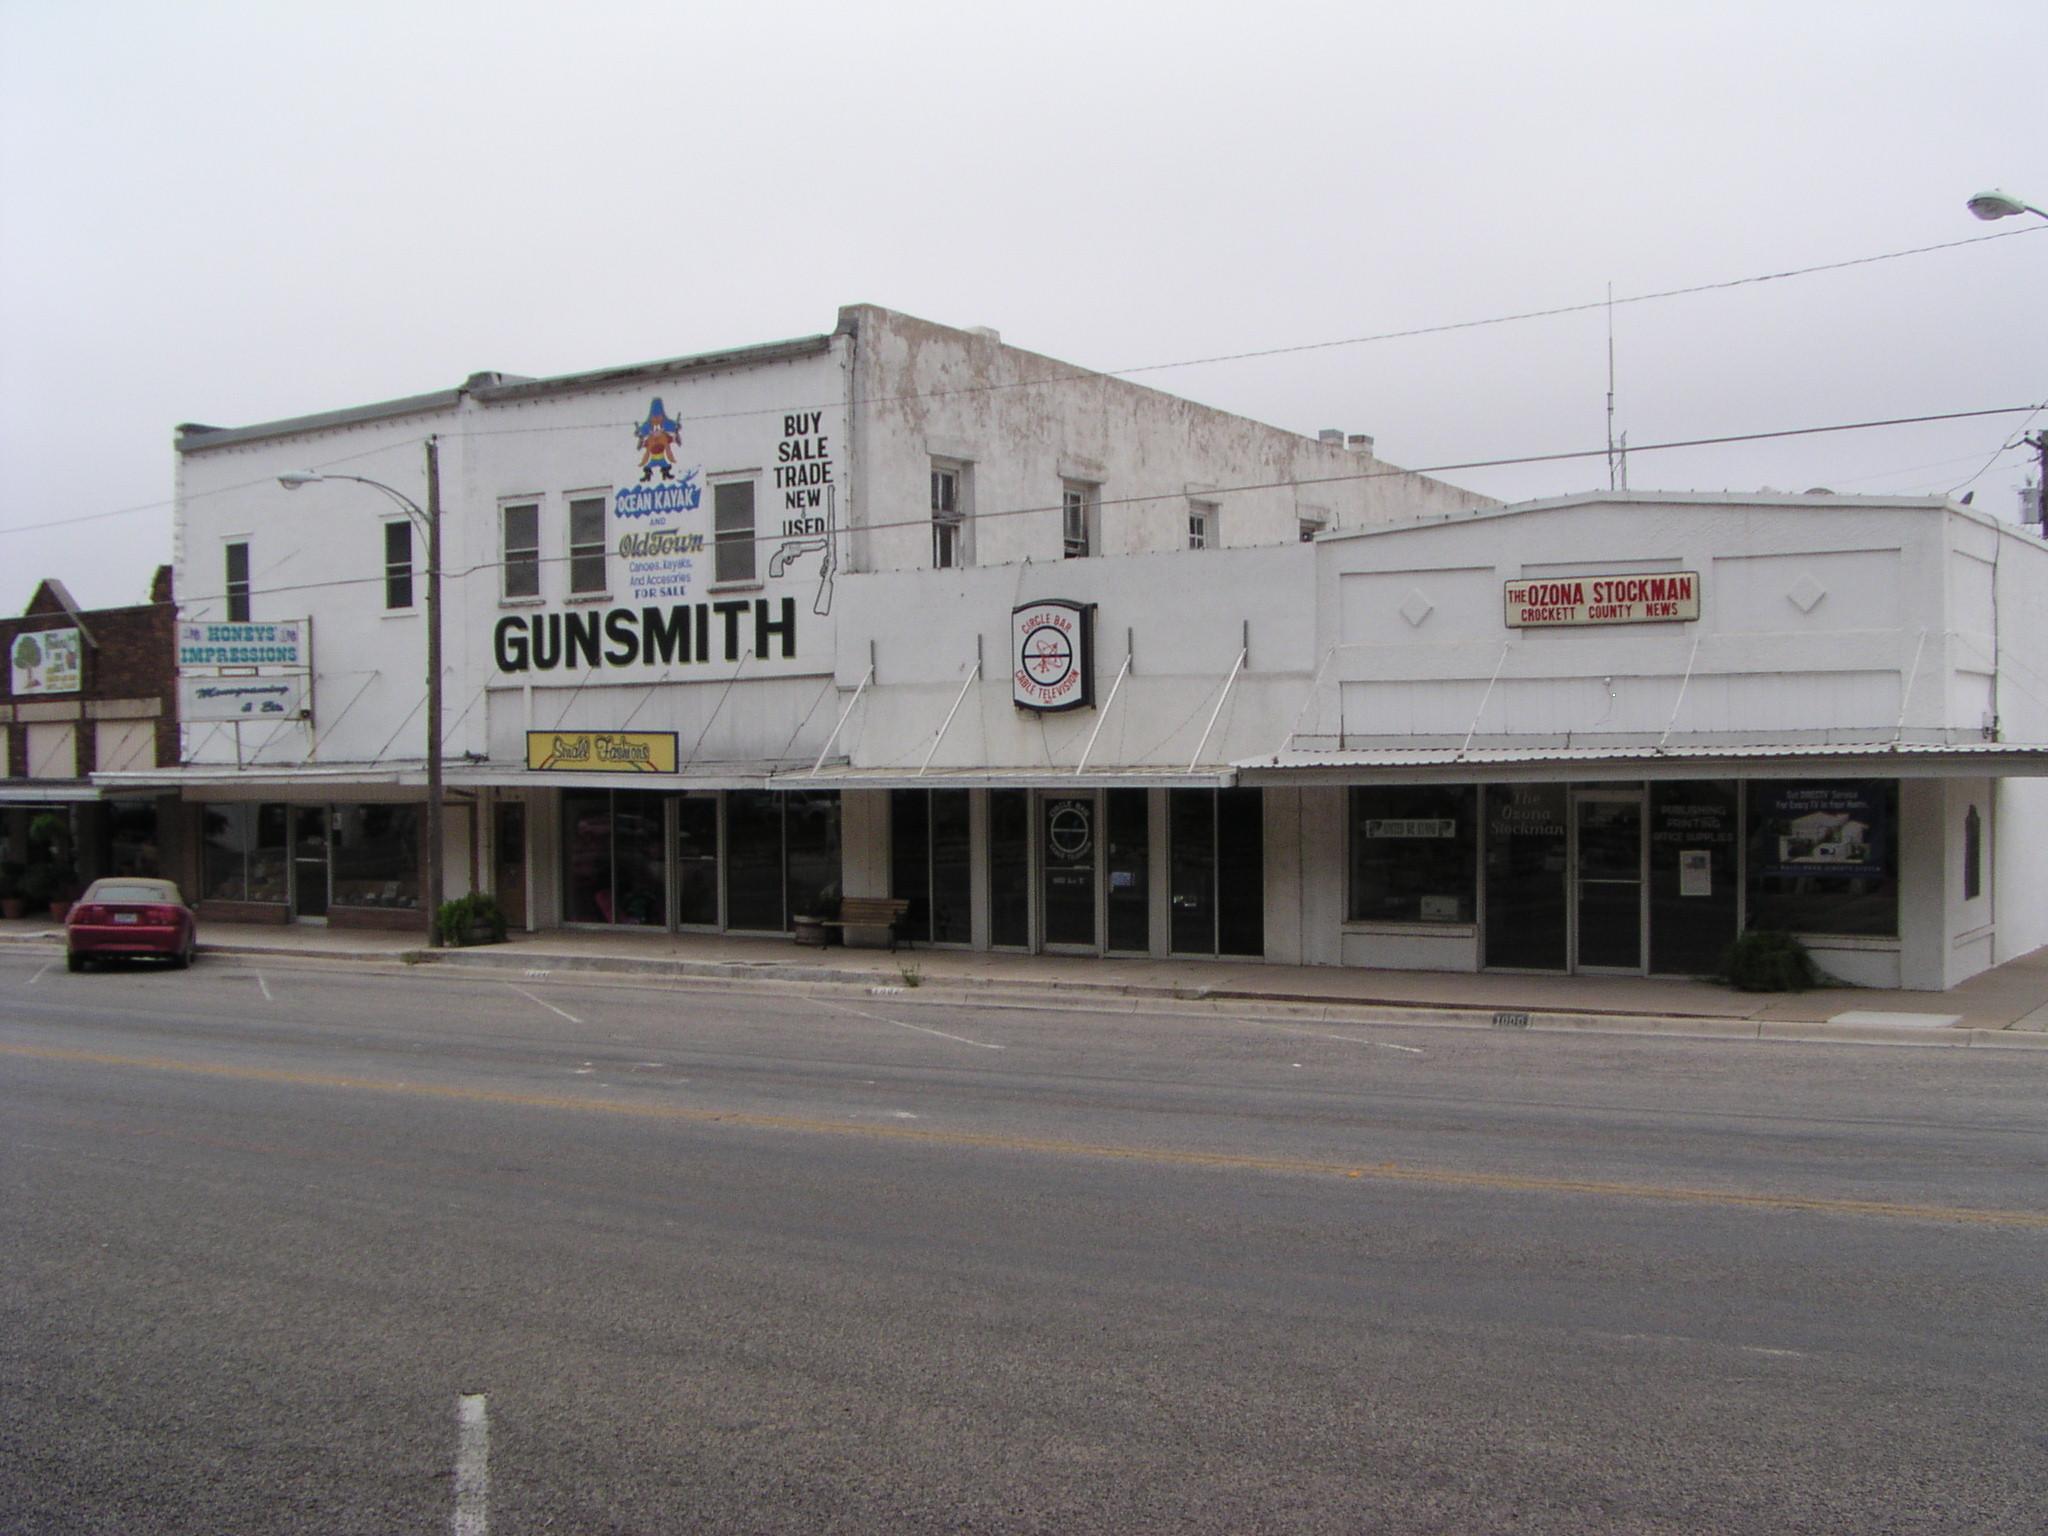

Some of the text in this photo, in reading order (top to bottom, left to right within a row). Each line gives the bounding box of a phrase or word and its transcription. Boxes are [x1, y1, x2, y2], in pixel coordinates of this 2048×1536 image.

[784, 411, 822, 437] BUY
[778, 437, 829, 462] SALE
[774, 461, 834, 488] TRADE
[617, 487, 694, 513] OCEAN KAYAK
[786, 488, 821, 509] NEW
[649, 517, 666, 526] AND
[783, 518, 825, 537] USED
[634, 586, 686, 599] FOR SALE
[1508, 577, 1692, 606] THE OZONA STOCKMAN
[1521, 602, 1679, 622] CROCKETT COUNTY NEWS
[494, 597, 797, 674] GUNSMITH
[1021, 613, 1073, 635] CIRCLE BAR
[181, 647, 297, 663] IMPRESSIONS
[1015, 668, 1080, 700] CABLE TELEVISION
